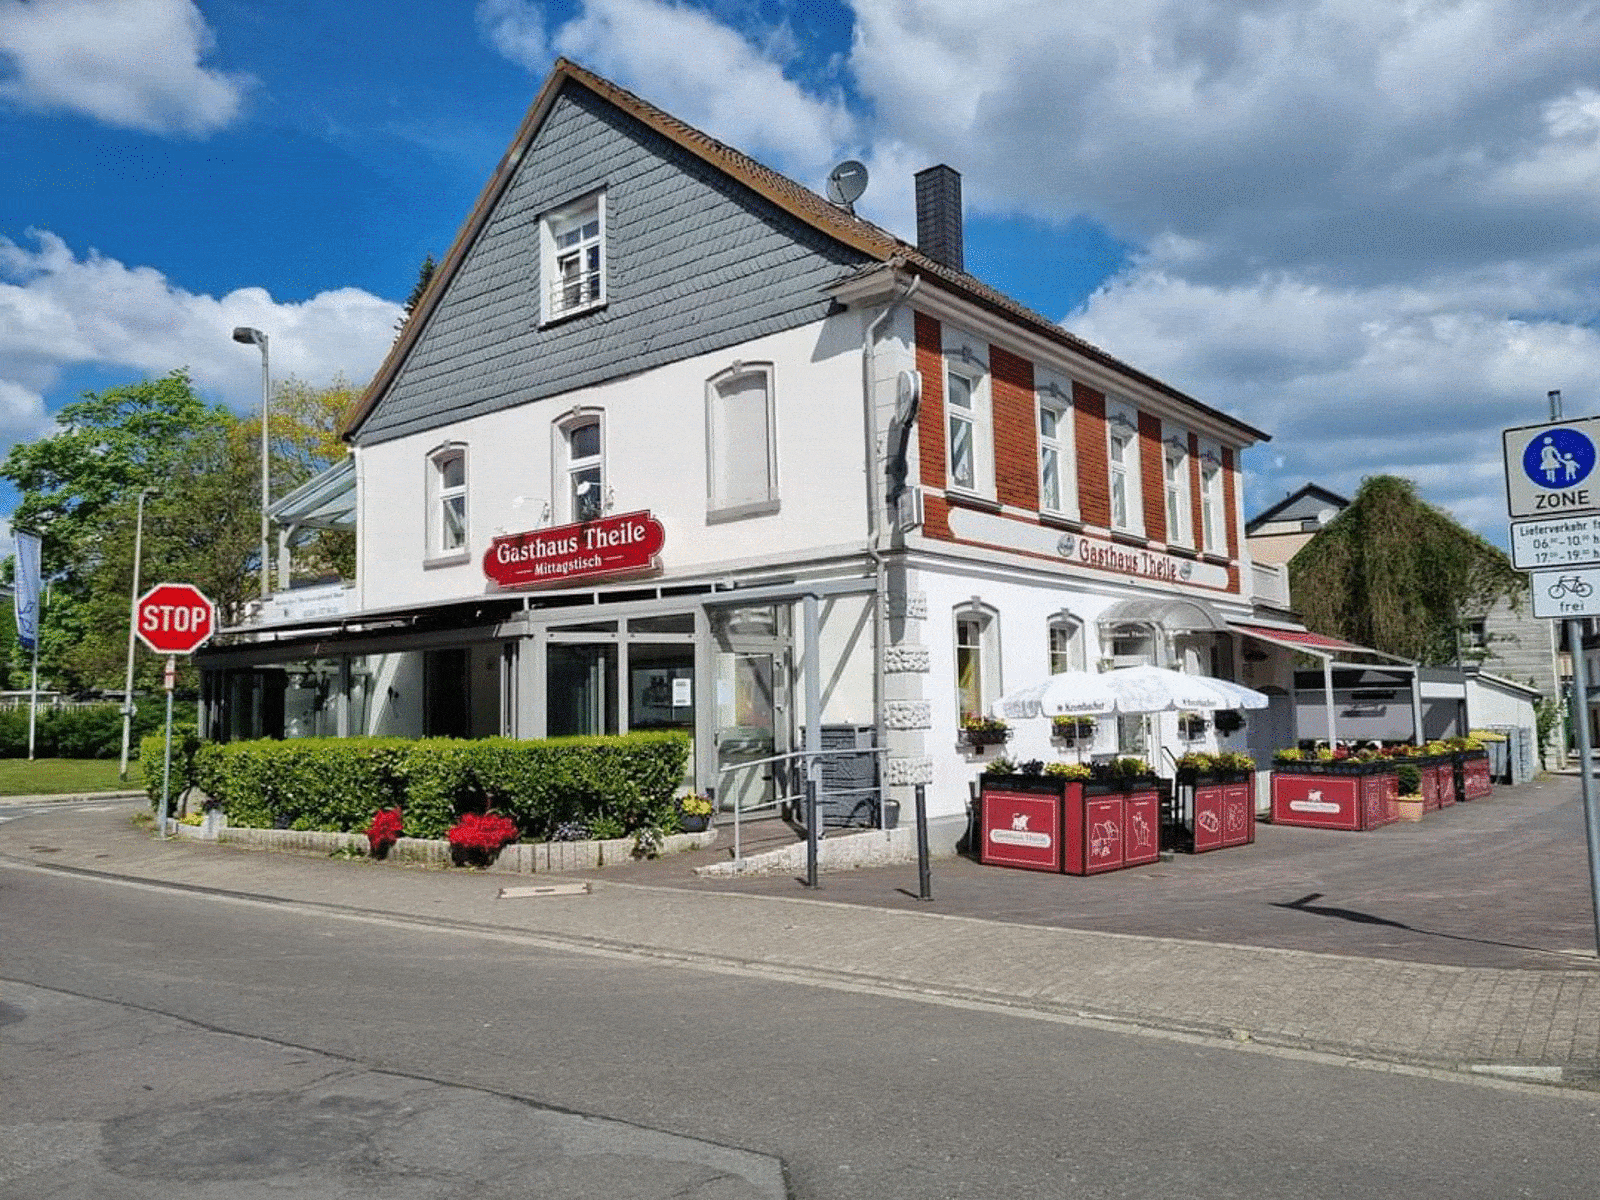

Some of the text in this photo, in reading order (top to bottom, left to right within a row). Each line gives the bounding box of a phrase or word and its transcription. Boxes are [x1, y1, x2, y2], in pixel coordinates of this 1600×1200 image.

[1535, 490, 1589, 509] ZONE
[1519, 521, 1588, 536] Lieferverkehr
[497, 521, 646, 564] Gasthaus Theile
[534, 555, 602, 576] Mittagstisch
[1079, 538, 1138, 572] Gasthaus
[1141, 552, 1177, 580] Theile
[1560, 601, 1585, 611] frei
[143, 605, 206, 632] STOP
